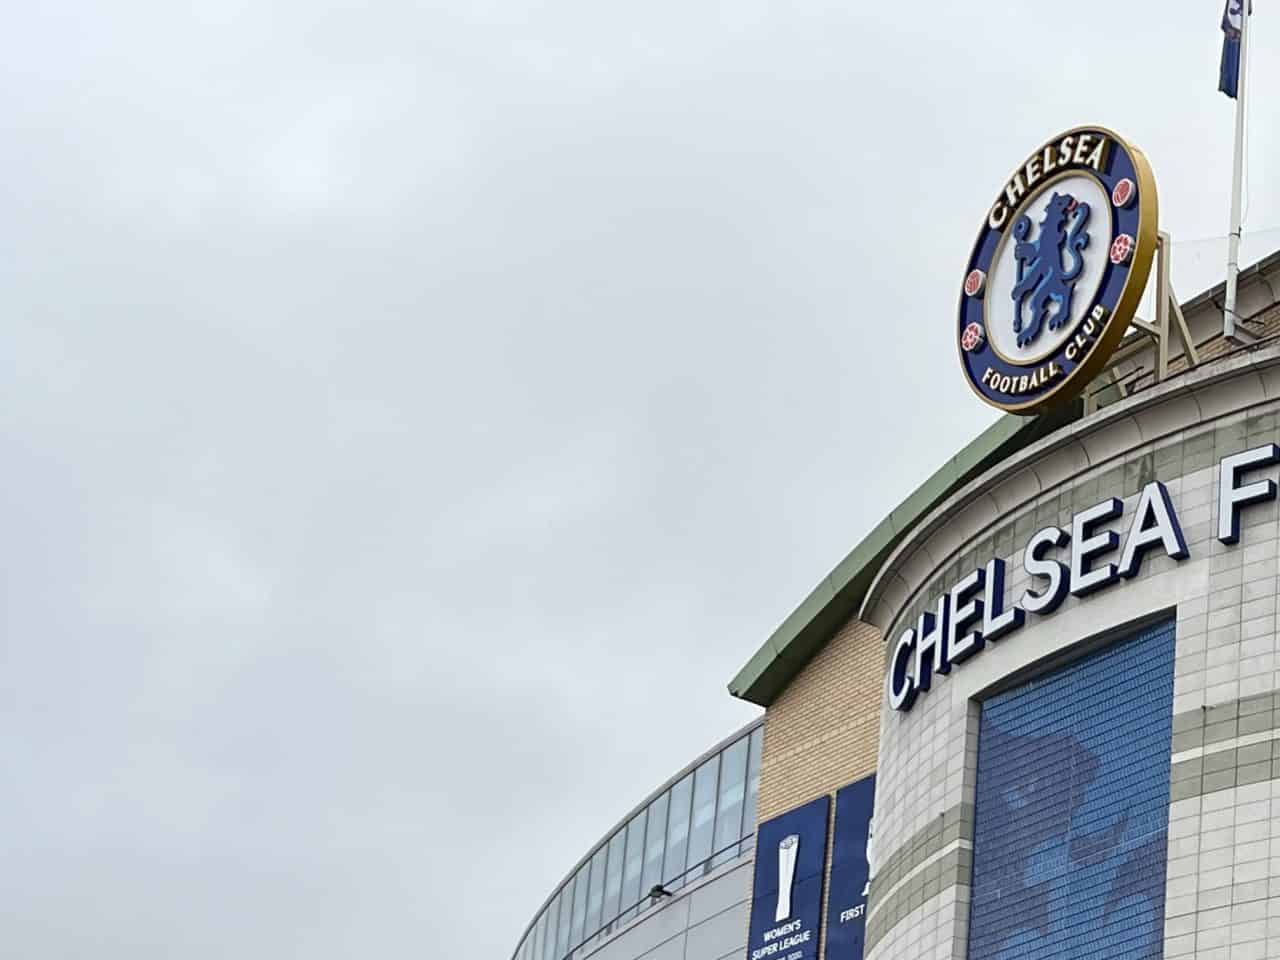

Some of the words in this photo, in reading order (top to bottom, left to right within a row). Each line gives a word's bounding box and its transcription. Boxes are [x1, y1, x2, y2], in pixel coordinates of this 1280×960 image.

[988, 134, 1105, 231] CHELSEA
[982, 362, 1060, 394] FOOTBALL
[1064, 304, 1105, 360] CLUB
[889, 480, 1190, 712] CHELSEA
[752, 942, 779, 960] SUPER
[779, 930, 811, 951] LEAGUE
[840, 904, 865, 923] FIRST
